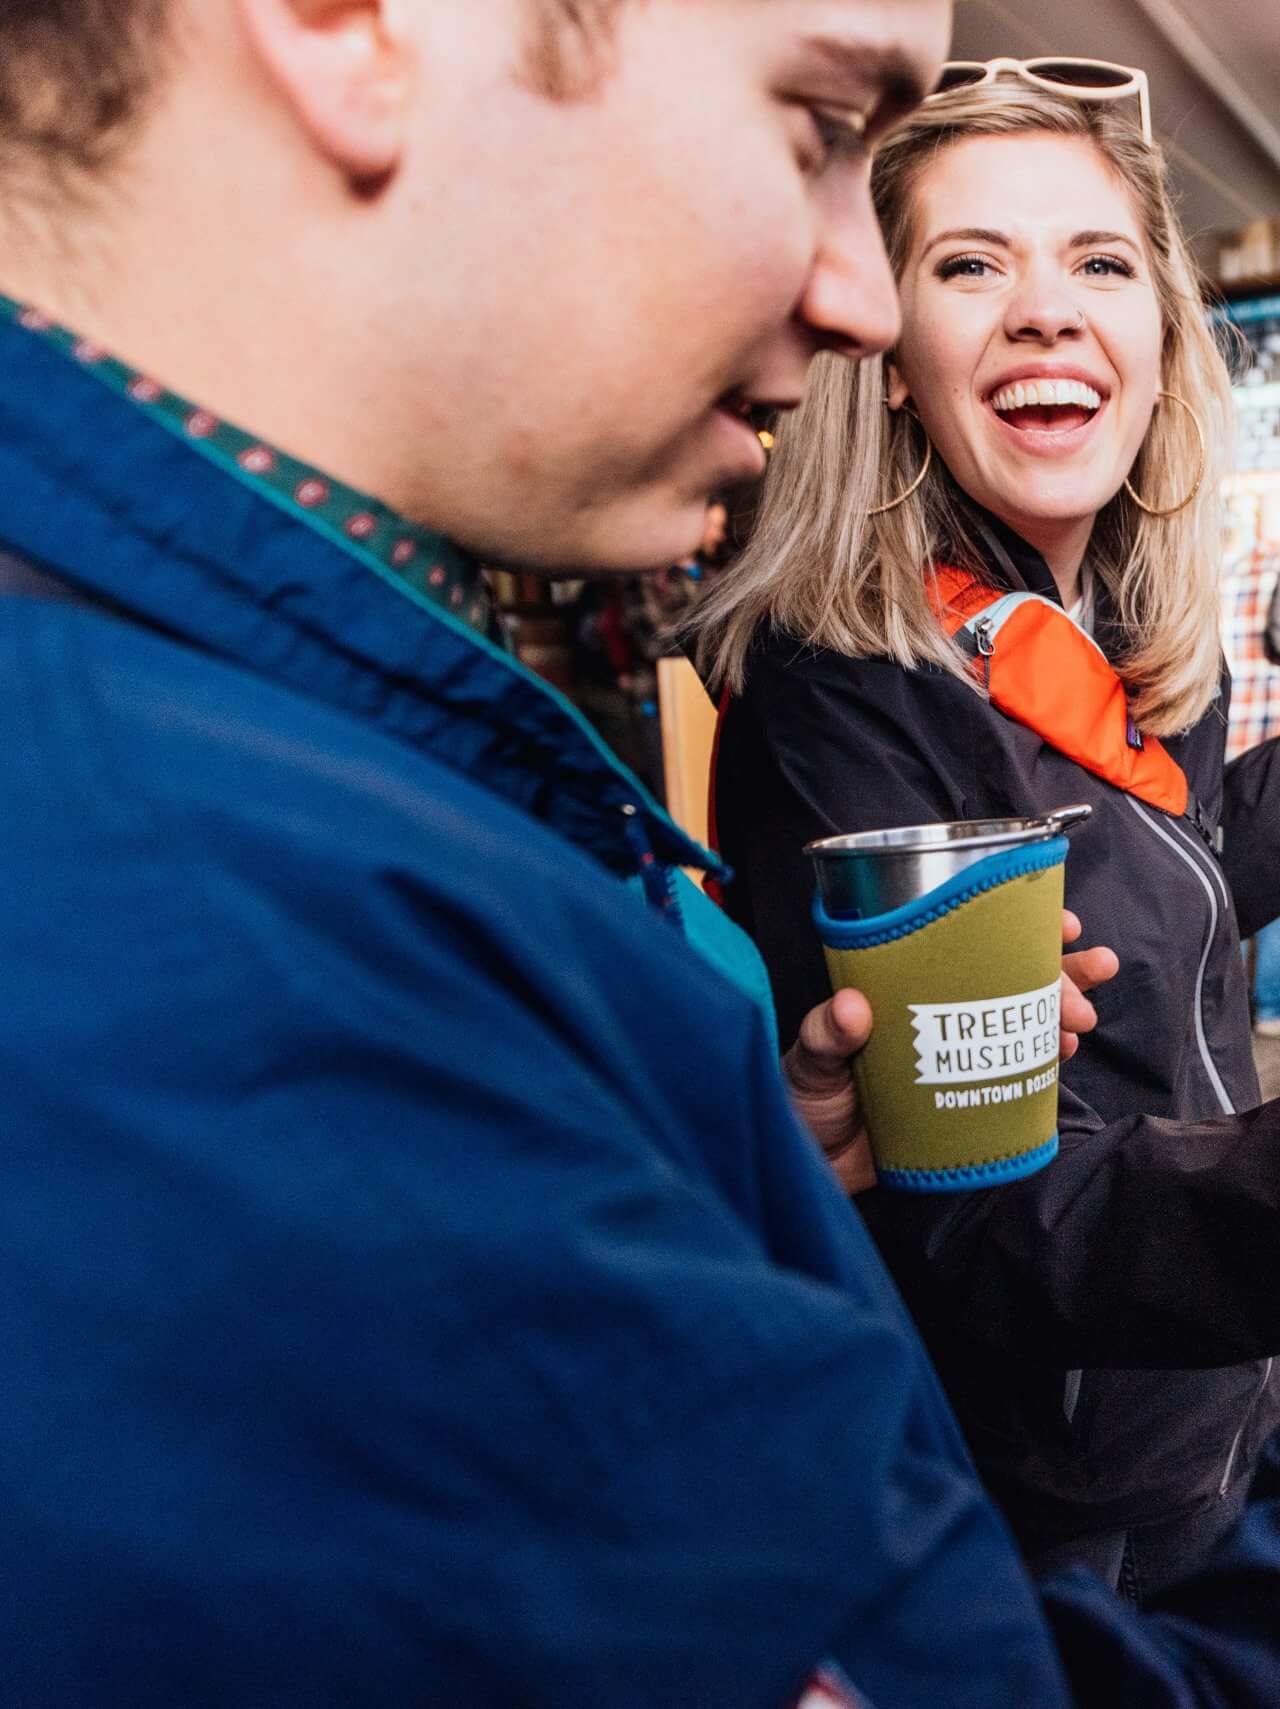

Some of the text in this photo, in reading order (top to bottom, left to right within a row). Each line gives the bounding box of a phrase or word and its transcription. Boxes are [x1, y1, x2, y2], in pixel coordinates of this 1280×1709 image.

[933, 992, 1057, 1042] TREEFOR
[935, 1026, 1058, 1074] MUSIC FES
[934, 1081, 1023, 1109] DOWNTOWN
